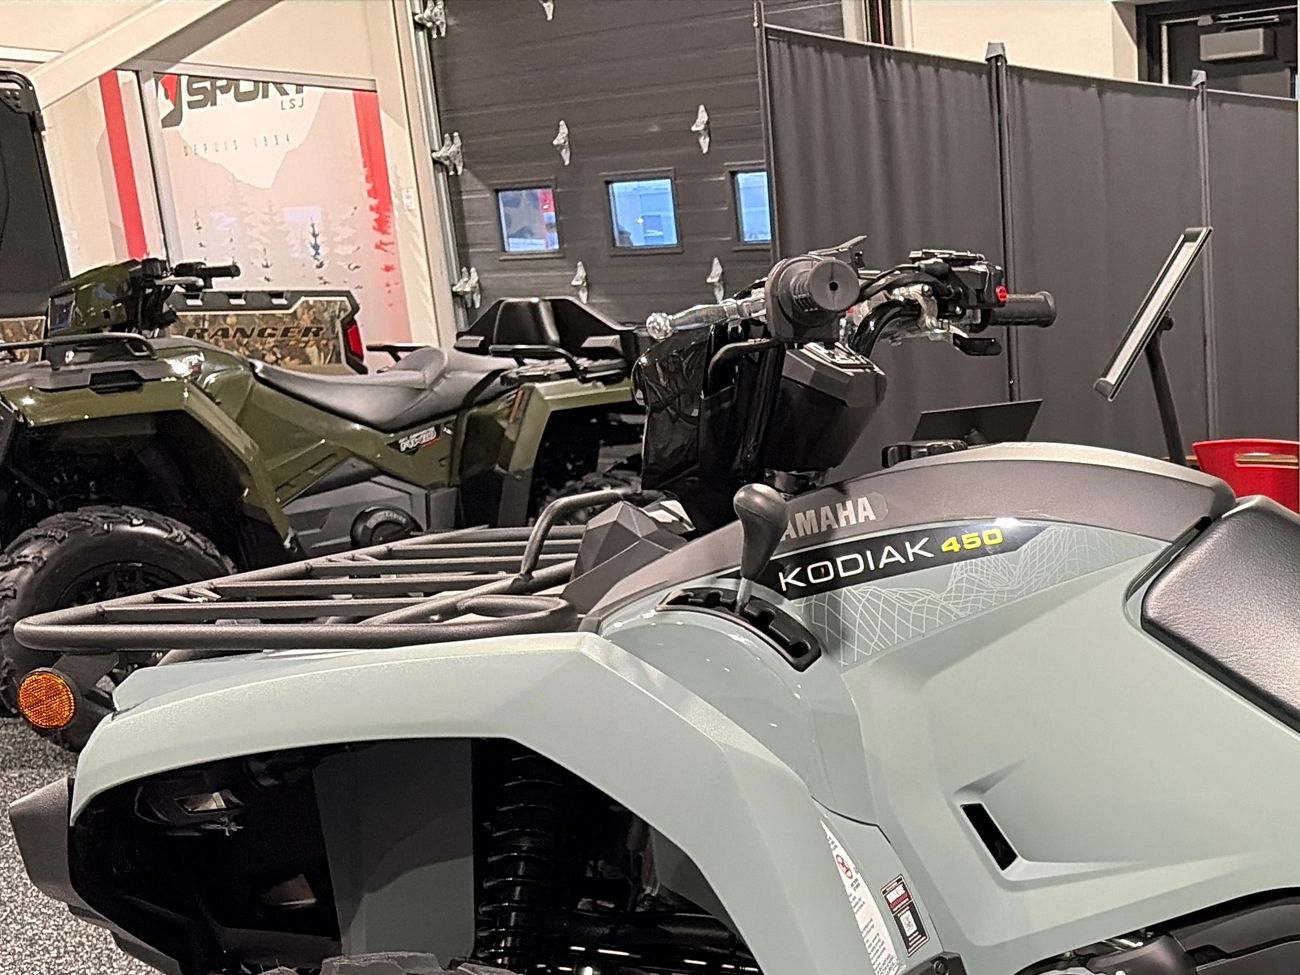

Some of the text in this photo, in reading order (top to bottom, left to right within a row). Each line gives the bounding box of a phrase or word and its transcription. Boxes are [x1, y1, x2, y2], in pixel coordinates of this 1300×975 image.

[280, 96, 305, 111] LSJ
[184, 325, 325, 340] RANGER
[780, 496, 877, 542] AMAHA
[777, 527, 1004, 593] KODIAK 450
